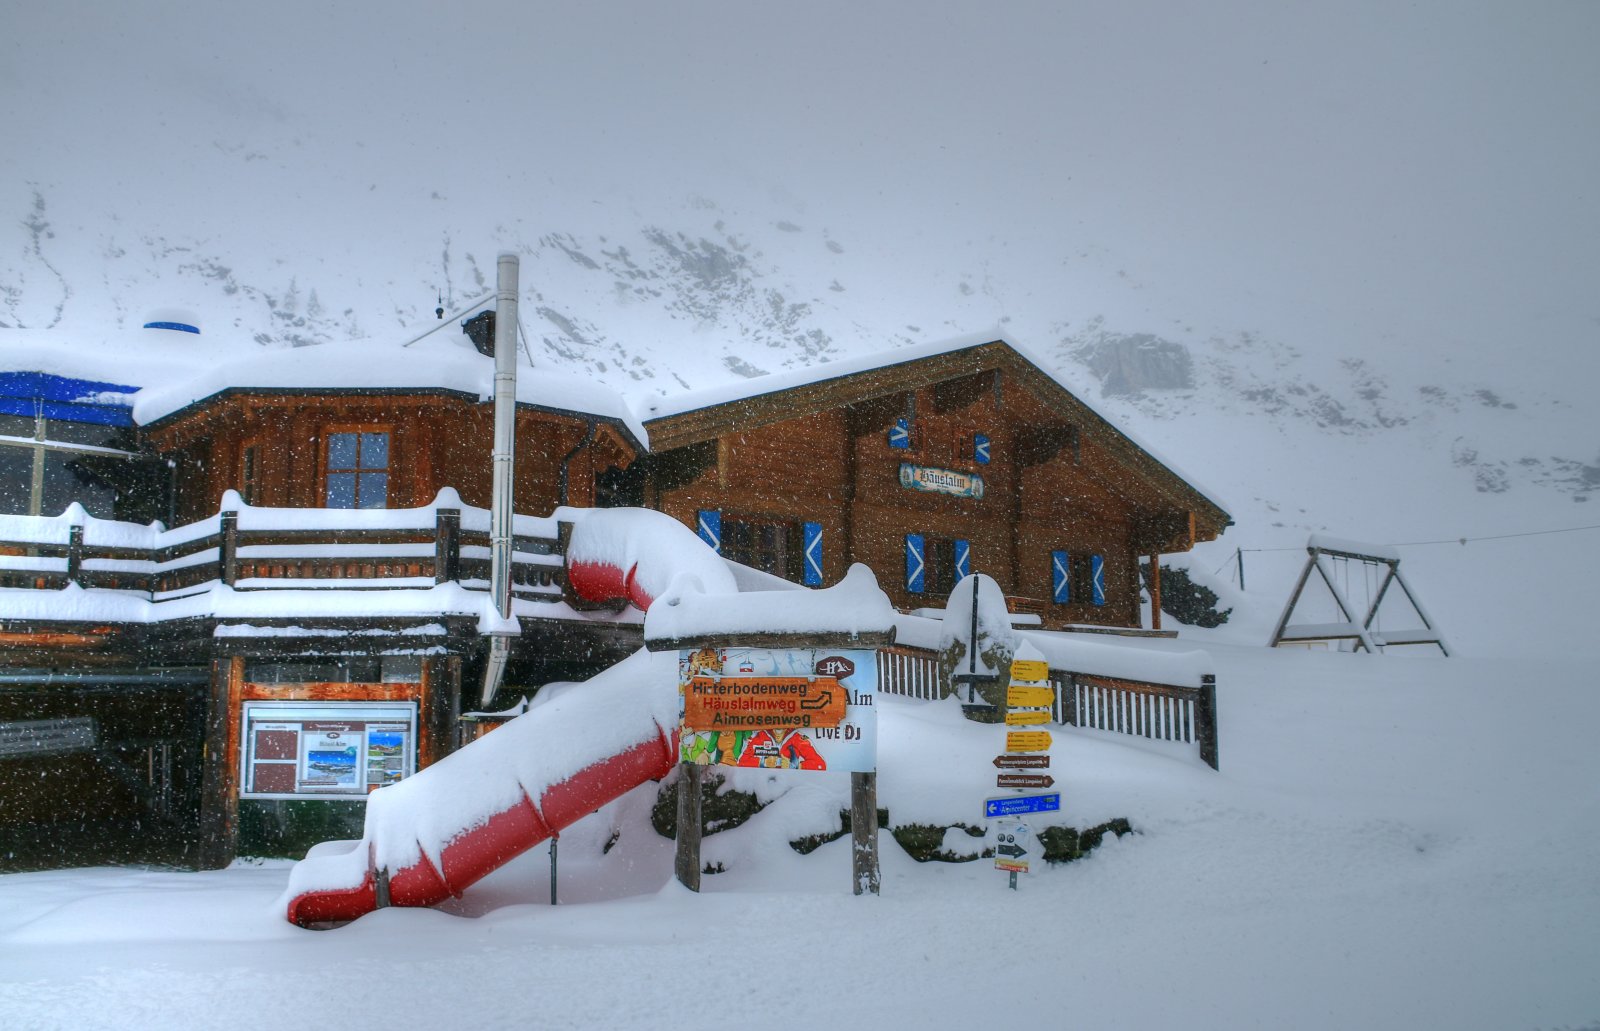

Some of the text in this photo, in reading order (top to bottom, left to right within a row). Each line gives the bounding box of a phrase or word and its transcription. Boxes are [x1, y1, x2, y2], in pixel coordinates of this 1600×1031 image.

[703, 697, 796, 713] Häuslalmweg
[815, 725, 860, 740] LIVE DJ
